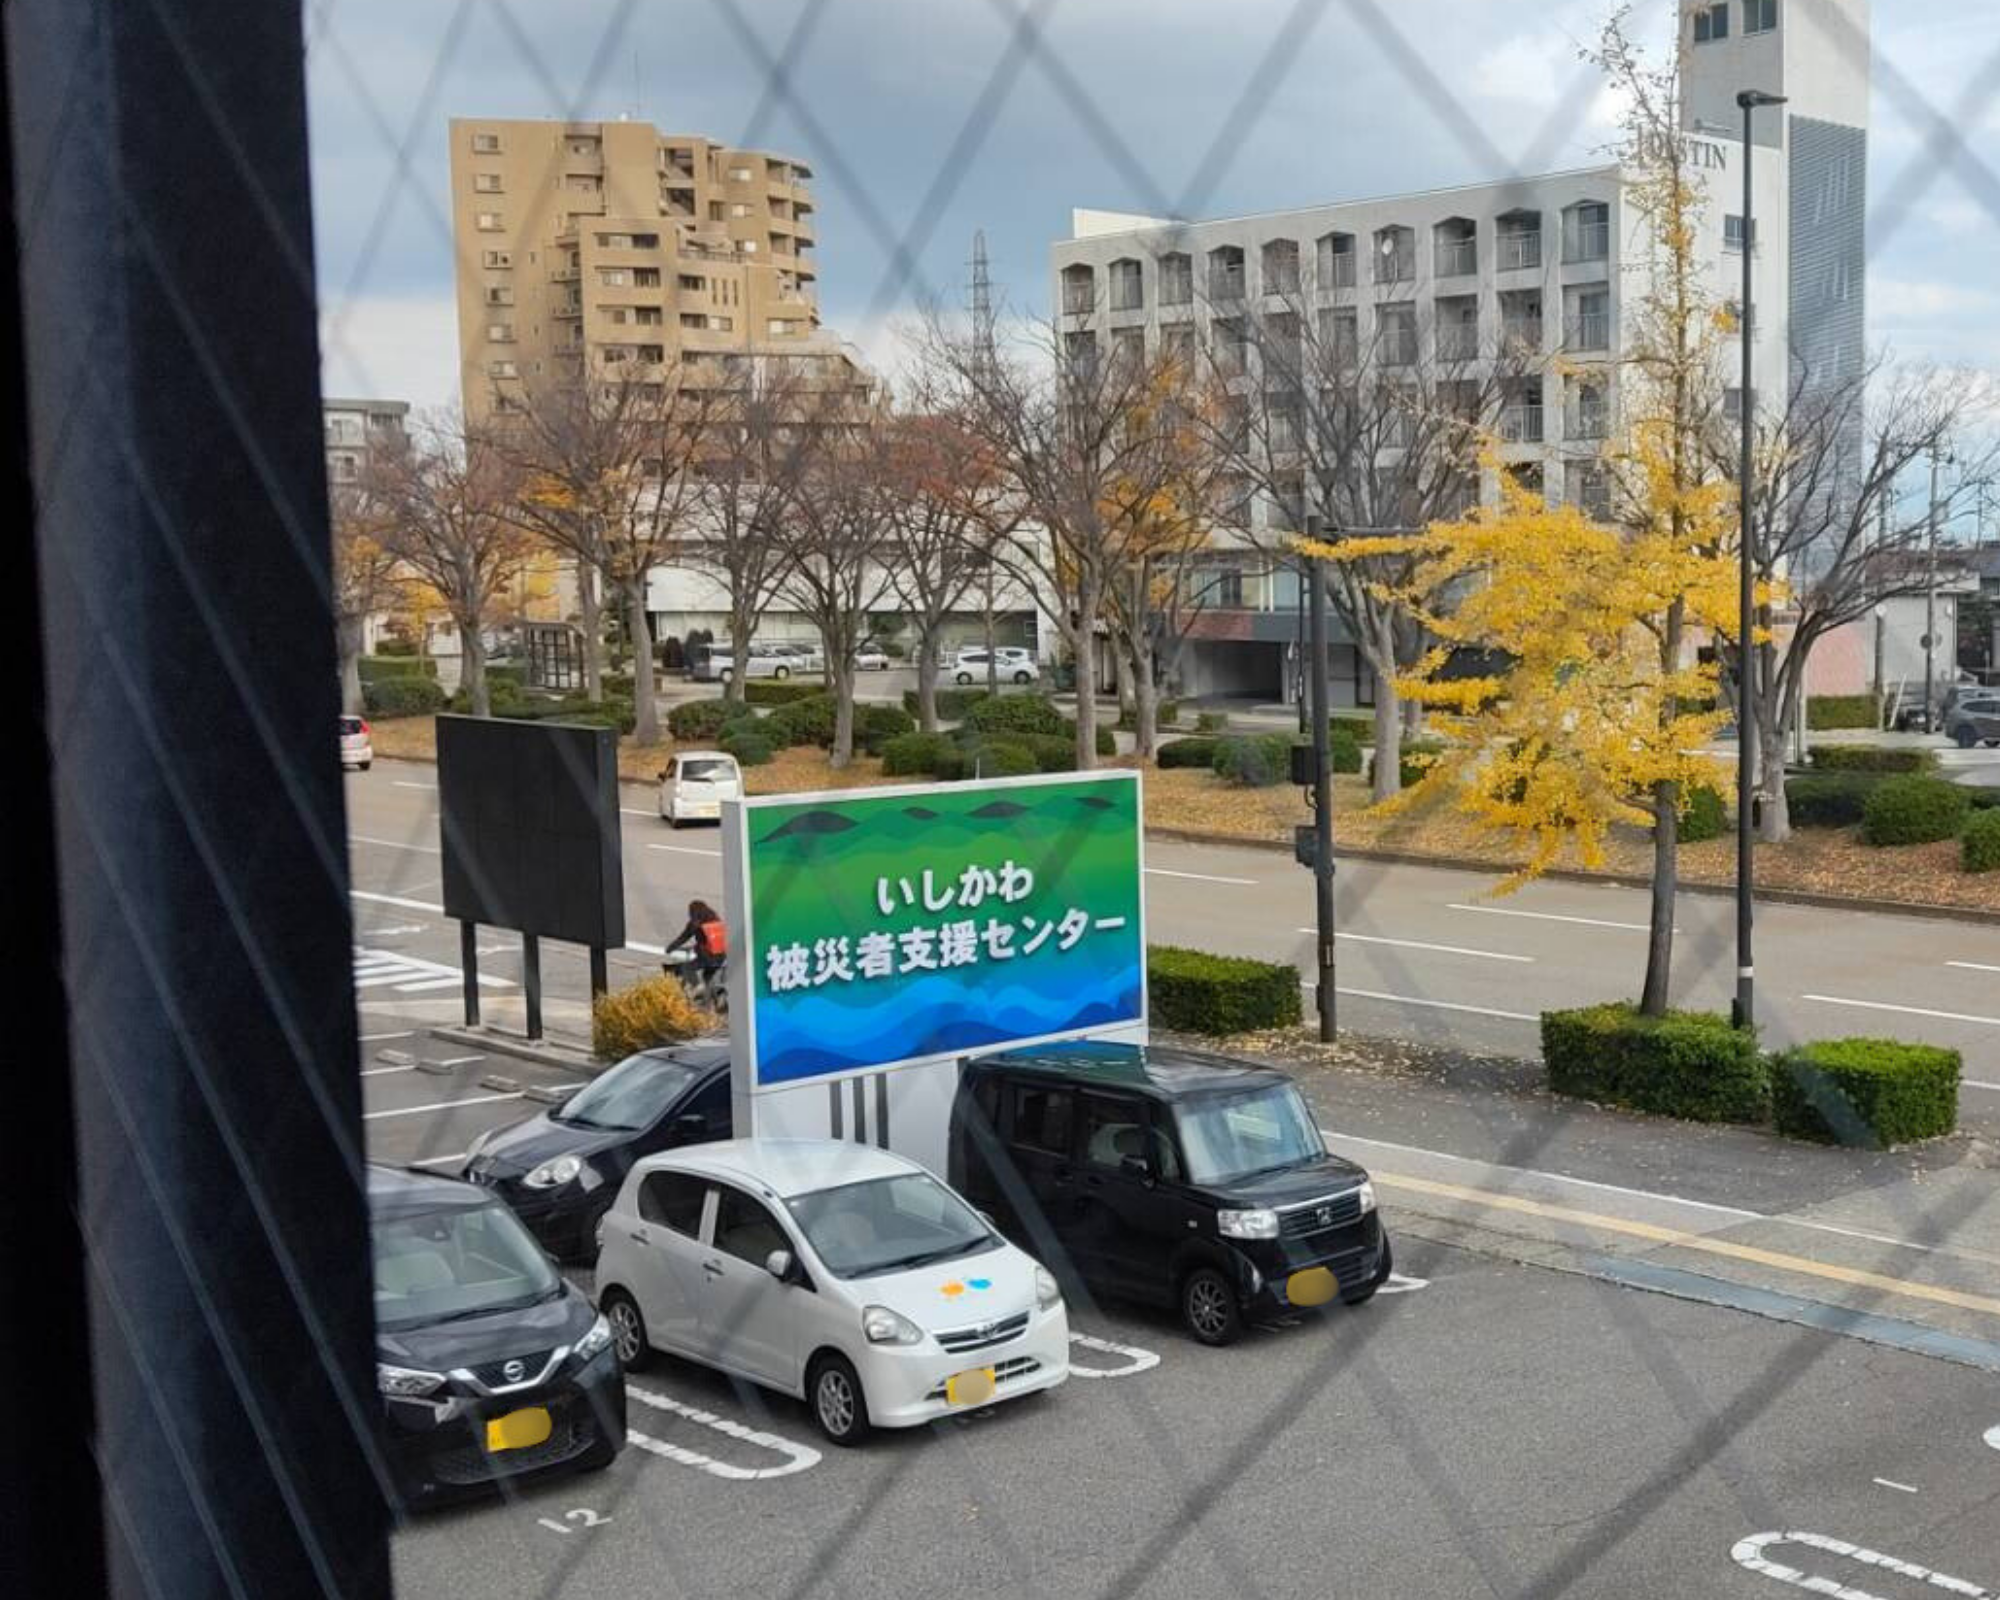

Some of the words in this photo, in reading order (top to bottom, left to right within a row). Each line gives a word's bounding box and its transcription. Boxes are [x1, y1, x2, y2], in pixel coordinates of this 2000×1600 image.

[877, 860, 1034, 915] いしかわ
[766, 907, 1126, 992] 被災者支援センター
[537, 1507, 613, 1533] 12
